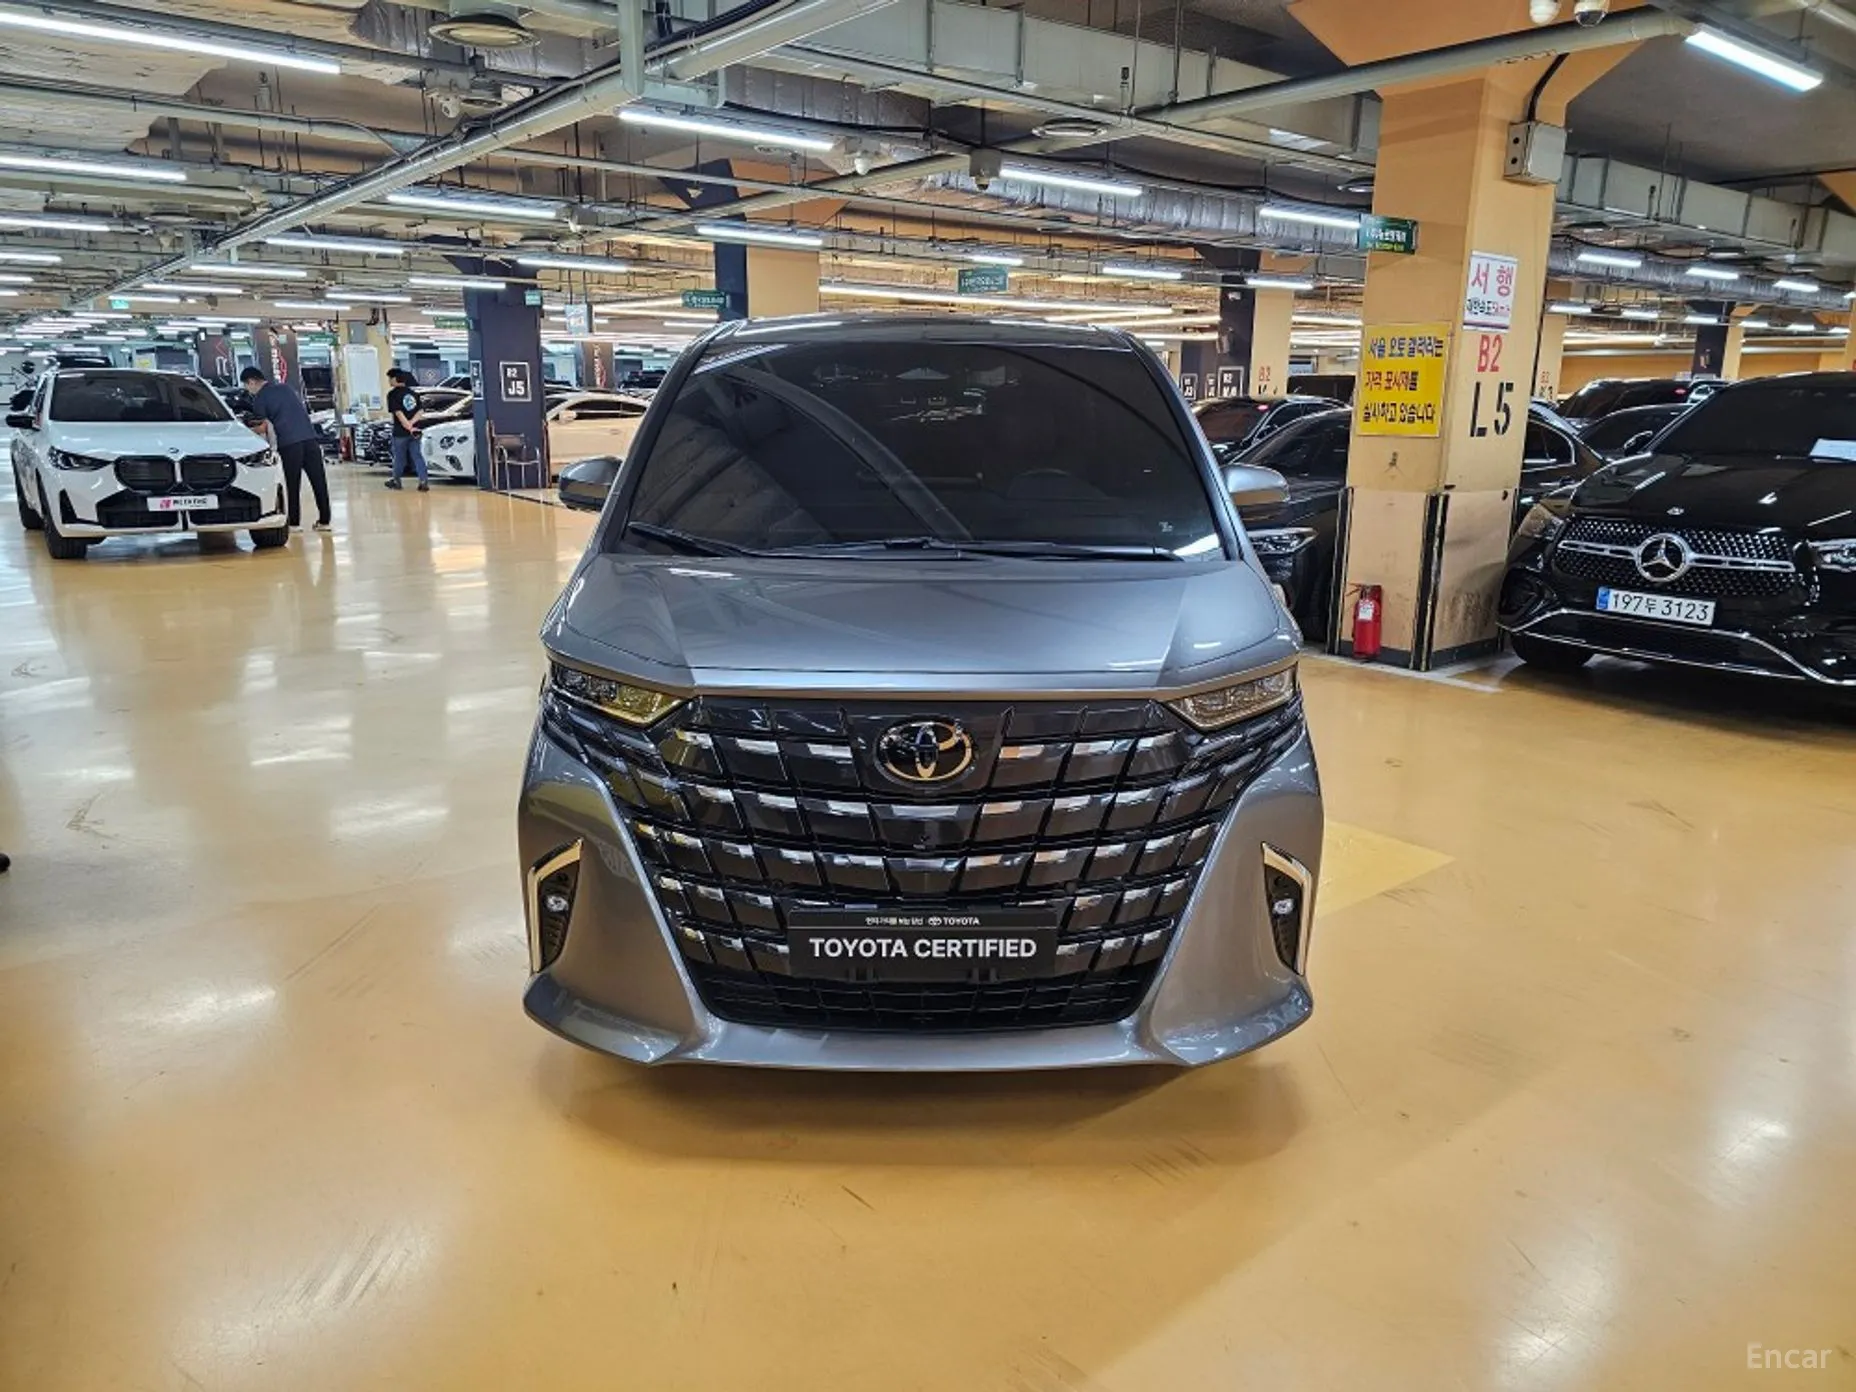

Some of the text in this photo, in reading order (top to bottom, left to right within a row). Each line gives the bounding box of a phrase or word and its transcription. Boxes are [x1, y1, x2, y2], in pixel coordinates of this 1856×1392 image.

[1368, 336, 1386, 358] 서울
[1477, 334, 1503, 372] B2
[506, 367, 518, 378] B2
[508, 381, 525, 396] J5
[1399, 402, 1436, 424] 있습니다
[1470, 381, 1514, 438] L5
[1661, 599, 1709, 621] 3123
[943, 916, 980, 926] TOYOTA
[809, 938, 1037, 958] TOYOTA CERTIFIED
